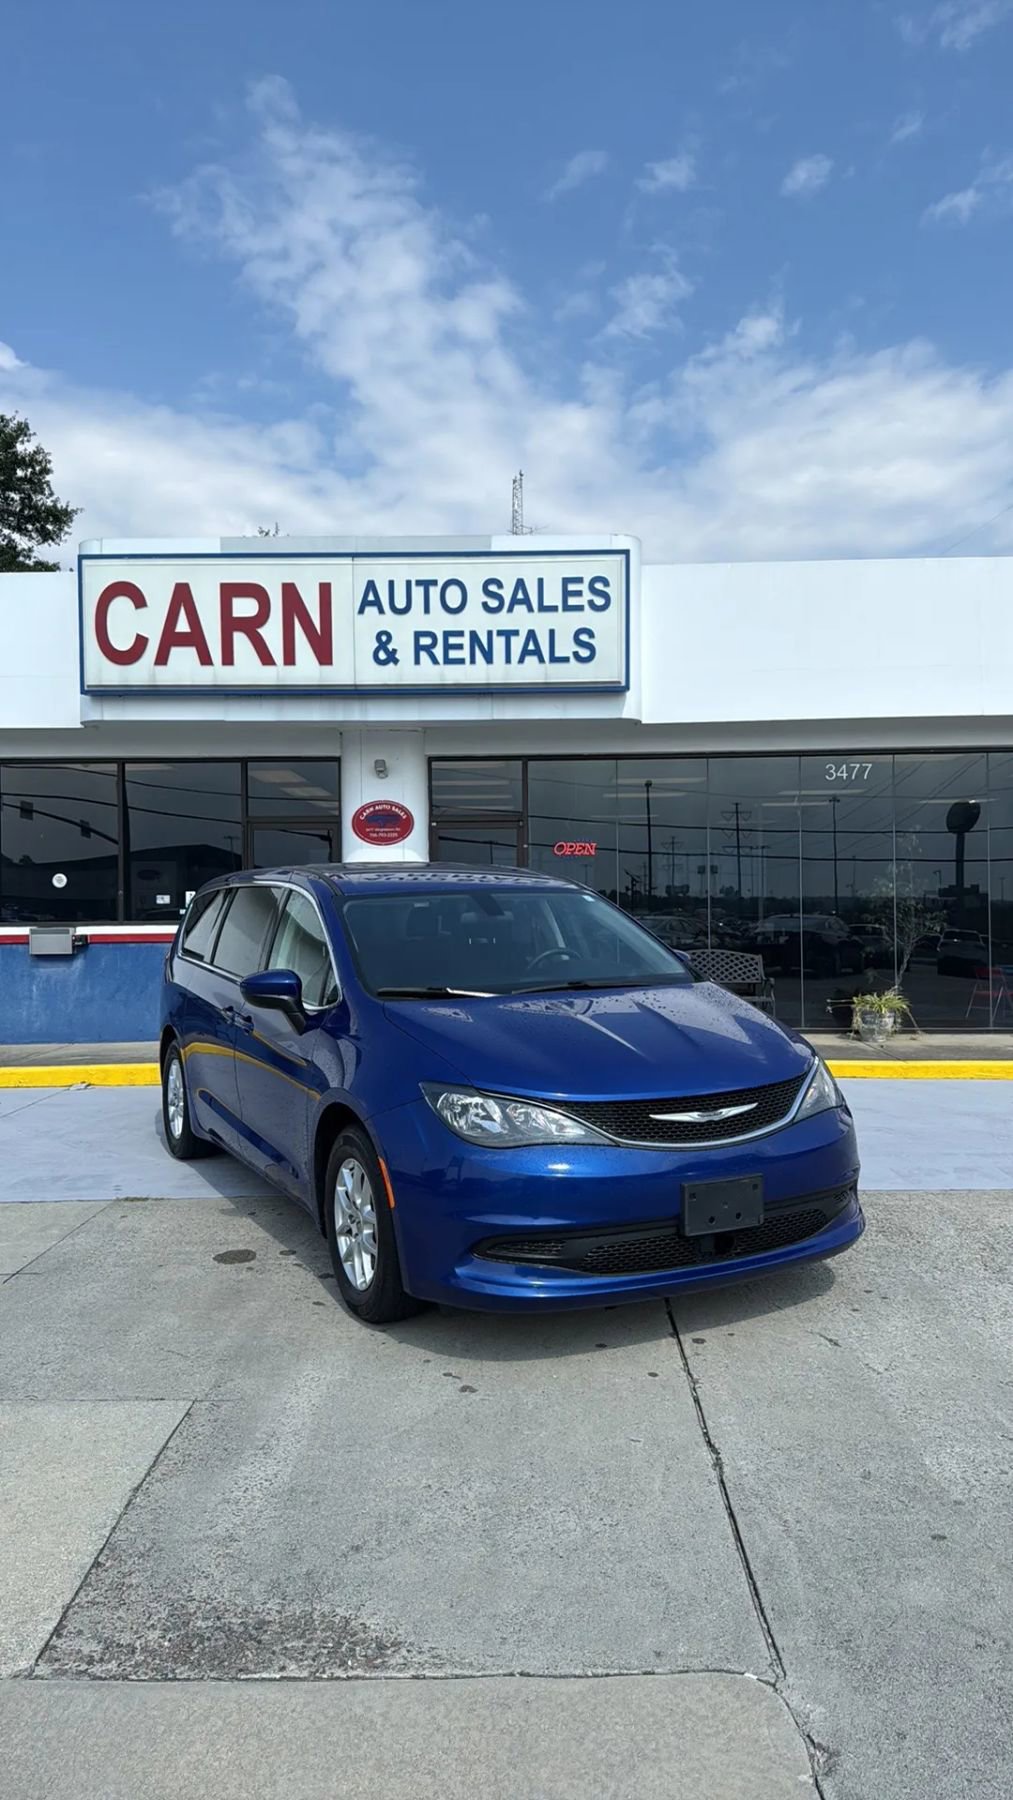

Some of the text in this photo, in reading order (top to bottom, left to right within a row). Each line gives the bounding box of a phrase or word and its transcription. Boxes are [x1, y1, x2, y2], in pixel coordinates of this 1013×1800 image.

[357, 575, 612, 616] AUTO SALES
[94, 580, 334, 667] CARN
[372, 627, 597, 666] & RENTALS
[825, 763, 873, 780] 3477
[392, 805, 407, 819] SALES
[553, 841, 597, 856] OPEN
